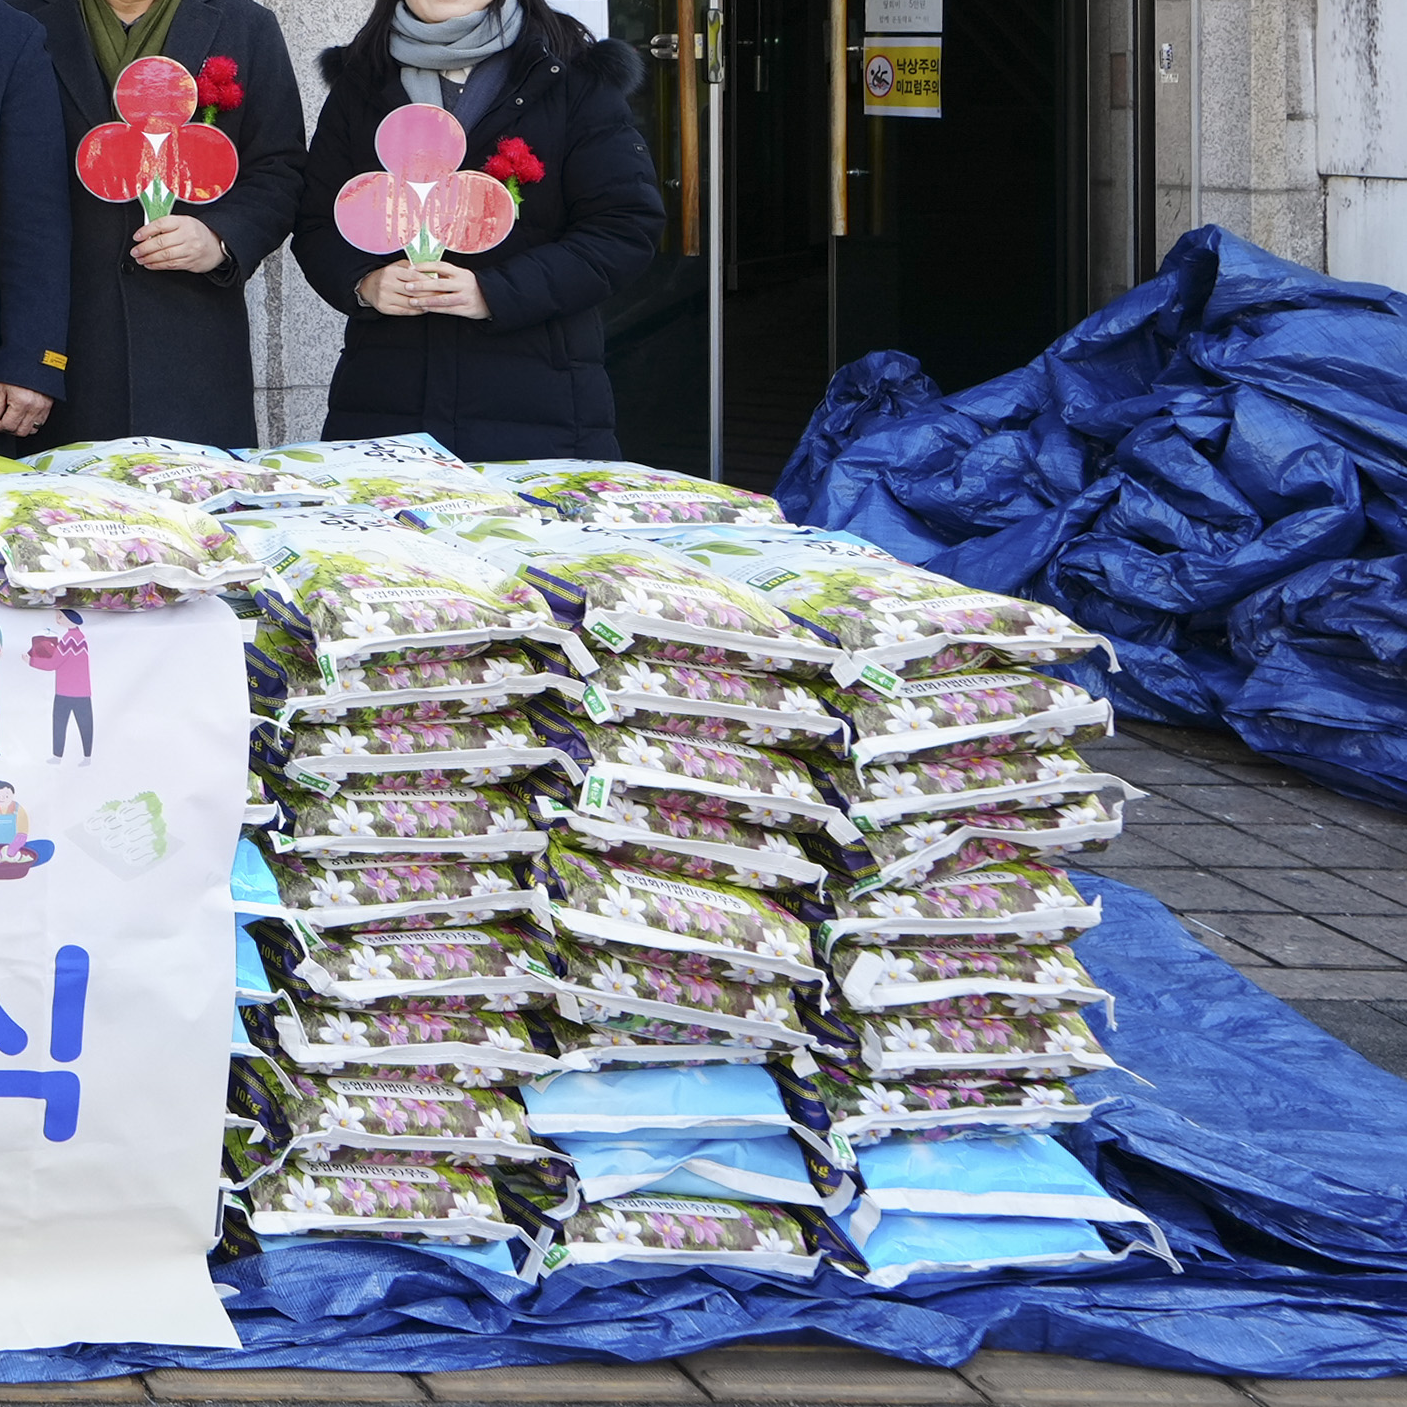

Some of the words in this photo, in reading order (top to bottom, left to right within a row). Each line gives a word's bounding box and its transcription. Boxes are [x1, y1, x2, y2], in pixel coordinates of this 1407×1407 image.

[896, 58, 939, 75] 낙상주의
[896, 80, 939, 97] 미끄럼주의
[766, 572, 800, 589] 10kg
[901, 674, 1020, 694] 농업회사법인(주)우농
[623, 873, 743, 911] 농업회사법인(주)우농
[261, 944, 282, 968] 10kg
[339, 1079, 455, 1097] 농업회사법인(주)우농
[237, 1086, 263, 1114] 10kg
[308, 1161, 430, 1180] 농업회사법인(주)우농
